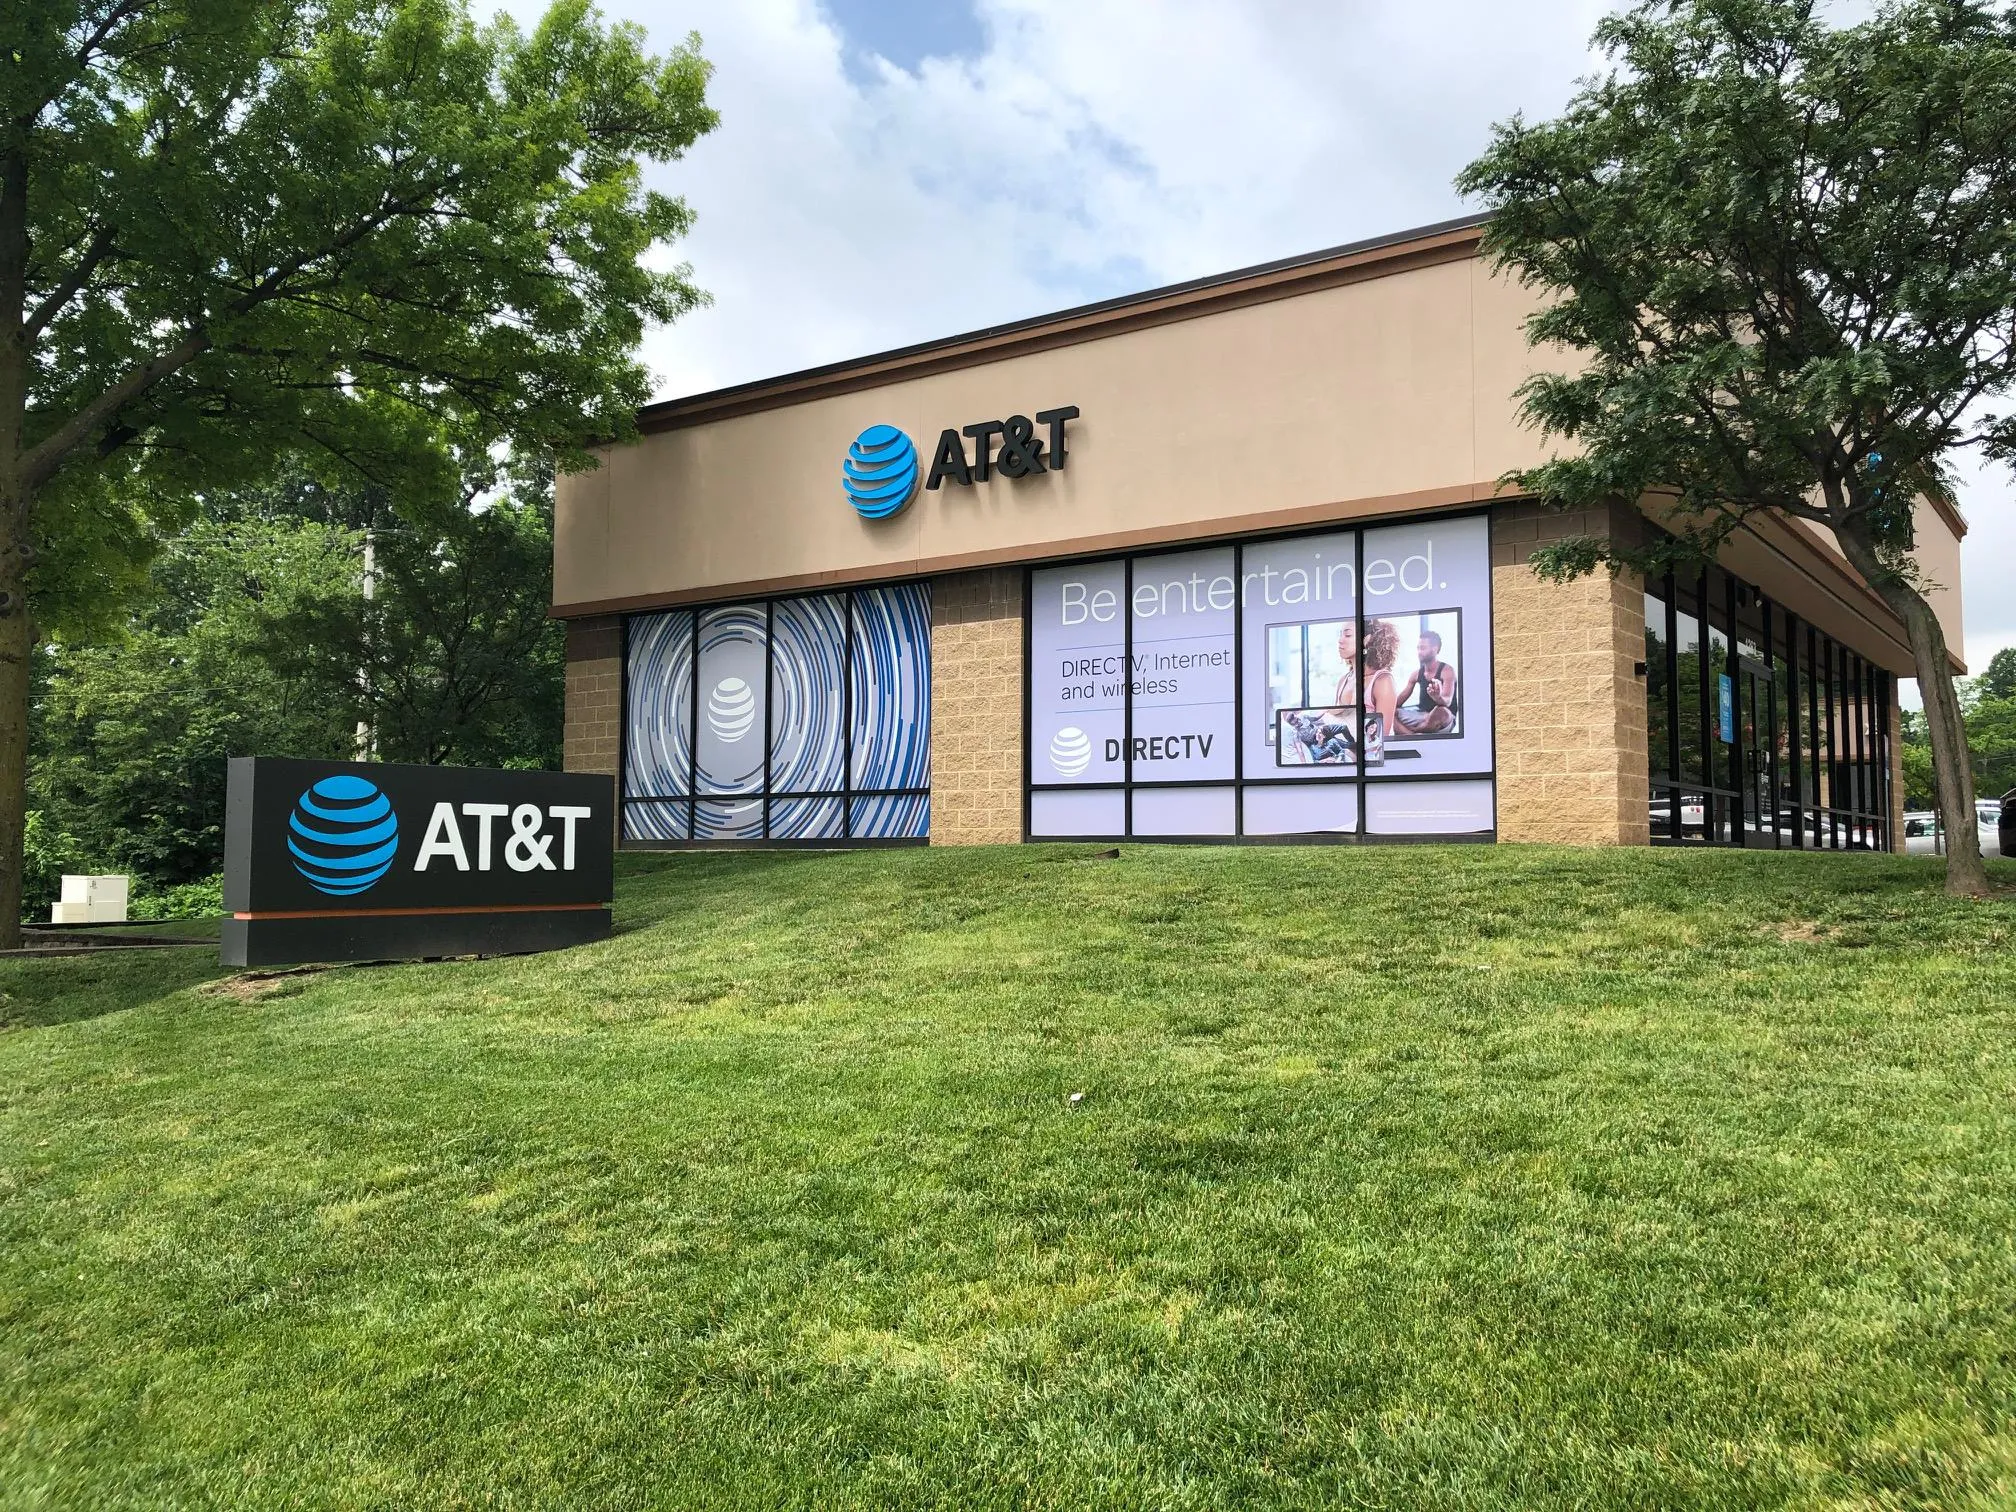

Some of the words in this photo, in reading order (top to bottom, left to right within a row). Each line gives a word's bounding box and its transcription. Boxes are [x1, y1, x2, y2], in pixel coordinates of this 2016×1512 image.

[926, 405, 1079, 490] AT&T
[1062, 582, 1117, 625] Be
[1132, 540, 1447, 618] entertained.
[1155, 649, 1231, 671] Internet
[1061, 681, 1095, 700] and
[1102, 677, 1178, 698] wireless
[1105, 734, 1214, 761] DIRECTV
[413, 802, 592, 872] AT&T
